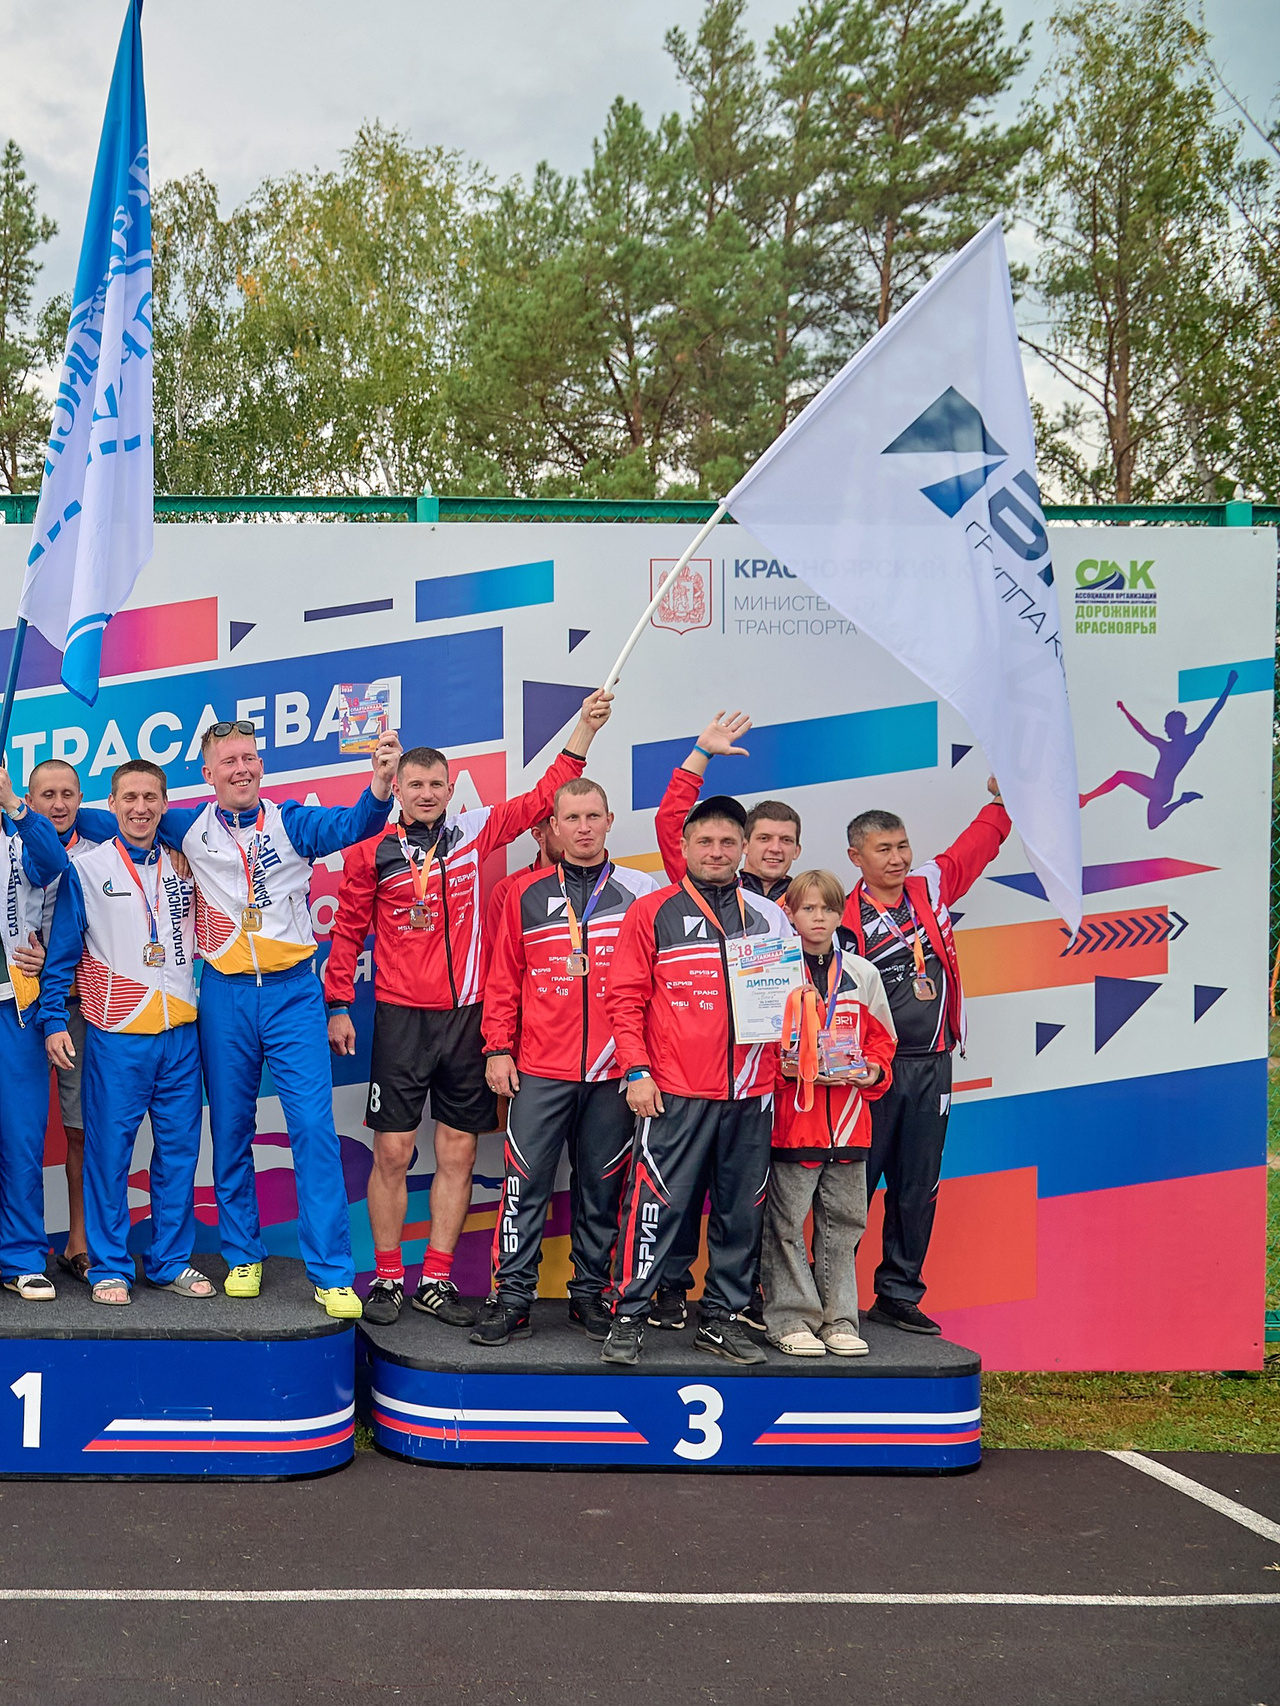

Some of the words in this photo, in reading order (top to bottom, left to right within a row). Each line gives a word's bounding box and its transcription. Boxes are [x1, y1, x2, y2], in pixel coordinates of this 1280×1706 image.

[1075, 605, 1157, 619] ДОРОЖНИКИ
[734, 619, 858, 635] ТРАНСПОРТА
[1075, 621, 1157, 634] КРАСНОЯРЬЯ
[162, 874, 187, 966] БАЛАХТИНСКОЕ
[737, 944, 752, 958] 18
[741, 951, 783, 964] СПАРТАКИАДА
[746, 978, 790, 988] ДИПЛОМ
[703, 1002, 714, 1010] ITS
[849, 1049, 865, 1068] 3
[503, 1175, 520, 1254] БРИЗ
[636, 1202, 660, 1281] БРИЗ
[9, 1372, 43, 1449] 1
[671, 1384, 724, 1461] 3
